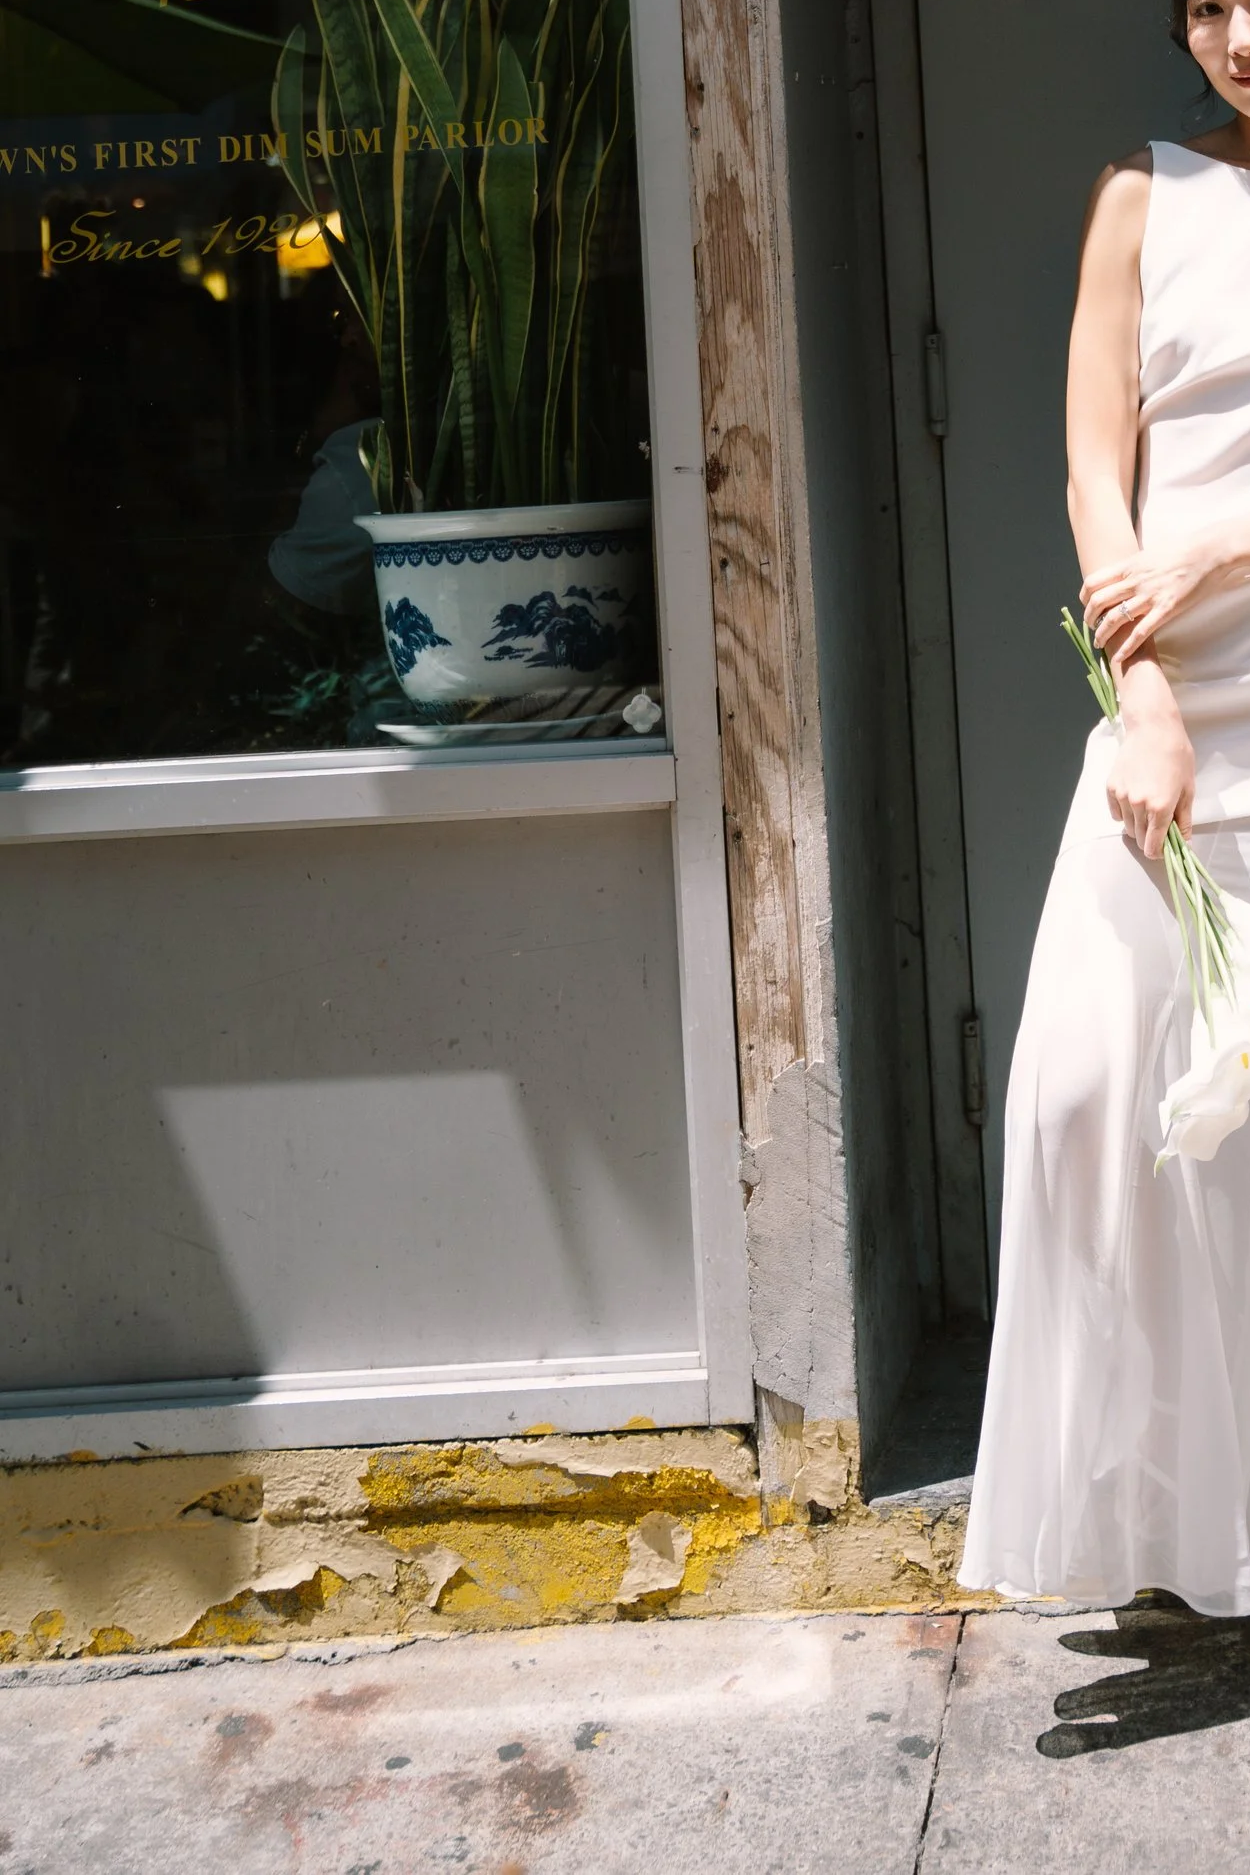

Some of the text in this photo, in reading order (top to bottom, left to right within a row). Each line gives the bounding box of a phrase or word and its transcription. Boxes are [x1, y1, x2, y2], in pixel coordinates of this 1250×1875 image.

[94, 136, 203, 171] FIRST
[218, 131, 289, 164] DIM
[305, 126, 386, 159] SUM
[402, 116, 549, 153] PARLOR
[49, 210, 331, 264] Since 1920
